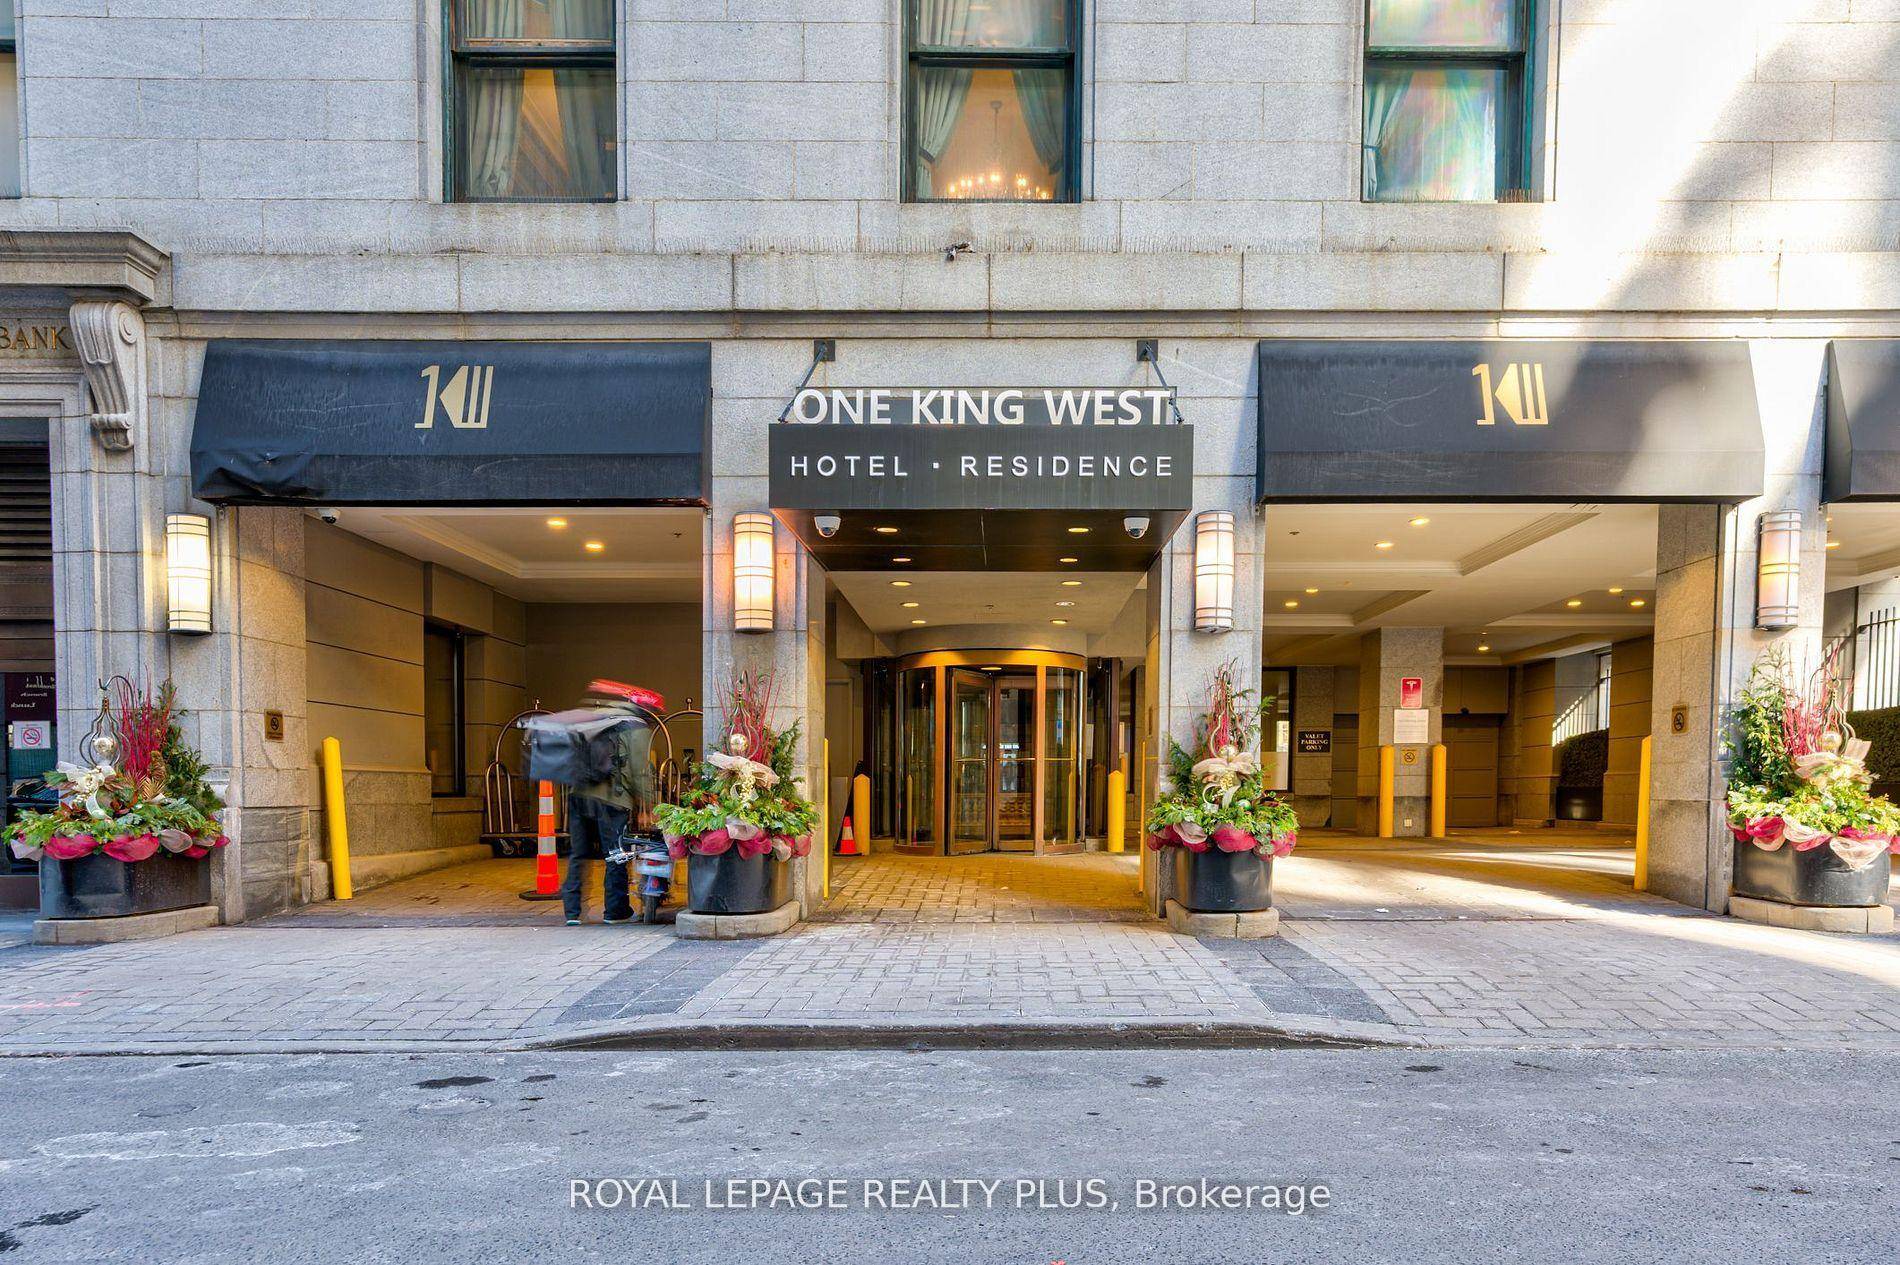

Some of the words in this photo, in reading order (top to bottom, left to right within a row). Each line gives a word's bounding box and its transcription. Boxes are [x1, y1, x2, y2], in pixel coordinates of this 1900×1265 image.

[793, 389, 891, 425] ONE
[912, 389, 1025, 425] KING
[1044, 389, 1171, 425] WEST
[790, 455, 908, 477] HOTEL
[960, 455, 1173, 477] RESIDENCE
